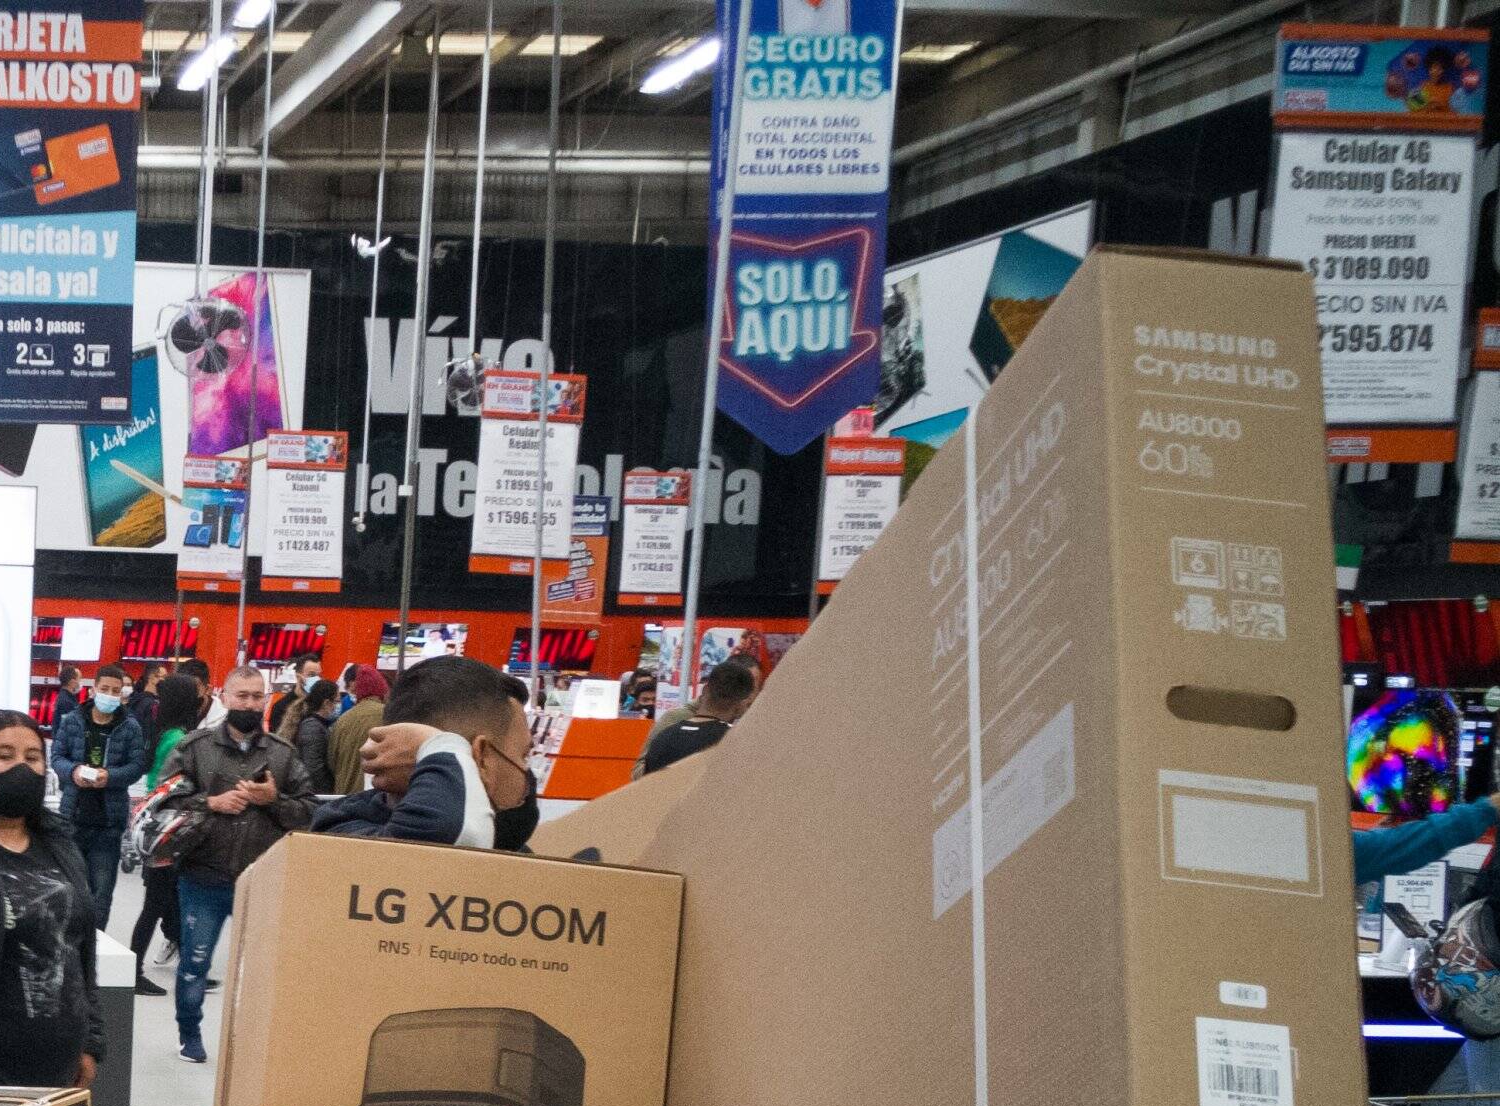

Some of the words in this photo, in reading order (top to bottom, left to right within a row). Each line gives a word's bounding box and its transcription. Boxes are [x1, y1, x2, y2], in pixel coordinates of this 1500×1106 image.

[746, 35, 884, 64] SEGURO
[744, 67, 884, 98] GRATIS
[761, 116, 817, 129] CONTRA
[823, 113, 860, 128] DAÑO
[746, 132, 787, 145] TOTAL
[792, 131, 877, 145] ACCIDENTAL
[1323, 138, 1400, 164] Celular
[755, 149, 773, 159] EN
[781, 148, 828, 159] TODOS
[833, 147, 861, 159] LOS
[739, 163, 824, 176] CELULARES
[829, 163, 881, 175] LIBRES
[1291, 165, 1386, 194] Samsung
[1390, 167, 1462, 194] Galaxy
[103, 229, 119, 259] y
[1324, 234, 1368, 248] PRECIO
[1370, 234, 1416, 249] OFERTA
[58, 267, 98, 300] ya!
[737, 260, 838, 305] SOLO
[1316, 295, 1365, 314] ECIO
[1371, 296, 1406, 314] SIN
[1411, 296, 1449, 314] IVA
[7, 317, 31, 332] solo
[35, 319, 44, 333] 3
[47, 319, 85, 336] pasos:
[1133, 323, 1277, 359] SAMSUNG
[16, 342, 29, 364] 2
[73, 343, 85, 366] 3
[1134, 352, 1238, 386] Crystal
[1243, 364, 1299, 392] UHD
[503, 425, 540, 438] Celular
[1138, 408, 1242, 441] AU8000
[356, 463, 398, 516] la
[348, 884, 406, 925] LG
[425, 891, 607, 947] XBOOM
[378, 939, 410, 956] RN5
[429, 945, 478, 964] Equipo
[484, 952, 517, 967] todo
[521, 958, 538, 970] en
[542, 960, 569, 973] uno
